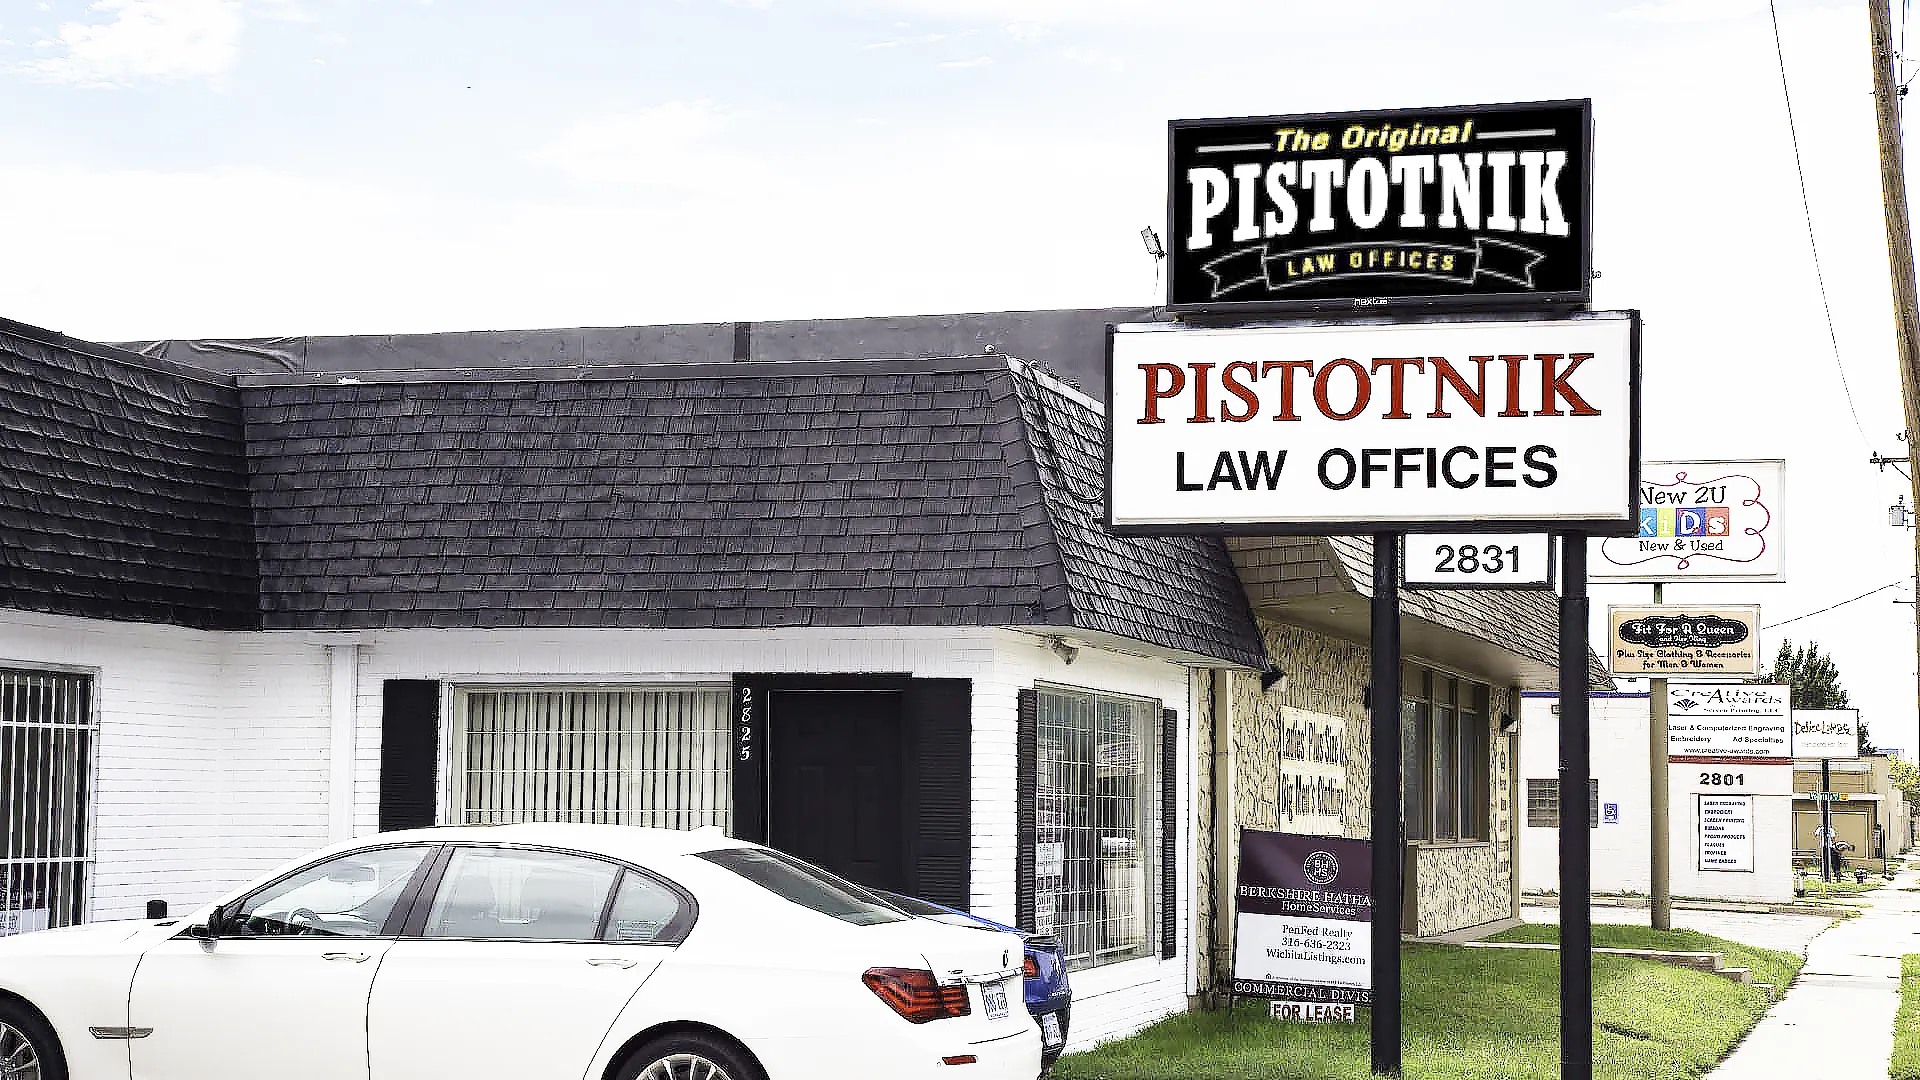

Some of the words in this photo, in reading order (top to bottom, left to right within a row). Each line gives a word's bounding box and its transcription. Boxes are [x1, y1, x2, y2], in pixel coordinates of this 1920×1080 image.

[1273, 126, 1329, 153] The
[1342, 120, 1475, 152] Original
[1186, 151, 1570, 251] PISTOTNIK
[1287, 254, 1337, 277] LAW
[1349, 249, 1456, 273] OFFICES
[1136, 352, 1602, 424] PISTOTNIK
[1175, 449, 1288, 492] LAW
[1317, 445, 1558, 490] OFFICES
[1640, 486, 1687, 505] New
[1694, 485, 1727, 504] 2U
[1639, 540, 1669, 552] New
[1673, 539, 1686, 552] &
[1690, 540, 1724, 552] Used
[1434, 544, 1521, 574] 2831
[1631, 623, 1652, 635] Fit
[1655, 623, 1678, 635] For
[1681, 622, 1692, 635] A
[1696, 623, 1735, 635] Queen
[740, 687, 752, 761] 2825
[1699, 772, 1744, 786] 2801
[1239, 885, 1321, 901] BERKSHIRE
[1324, 891, 1371, 906] HATHA
[1282, 901, 1356, 916] HomeServices
[1282, 924, 1319, 936] PenFed
[1322, 927, 1353, 940] Realty
[1266, 948, 1366, 965] WichitaListings.com
[1234, 982, 1326, 999] COMMERCIAL
[1331, 989, 1369, 1002] DIVIS
[1273, 1003, 1301, 1020] FOR
[1304, 1004, 1352, 1021] LEASE
